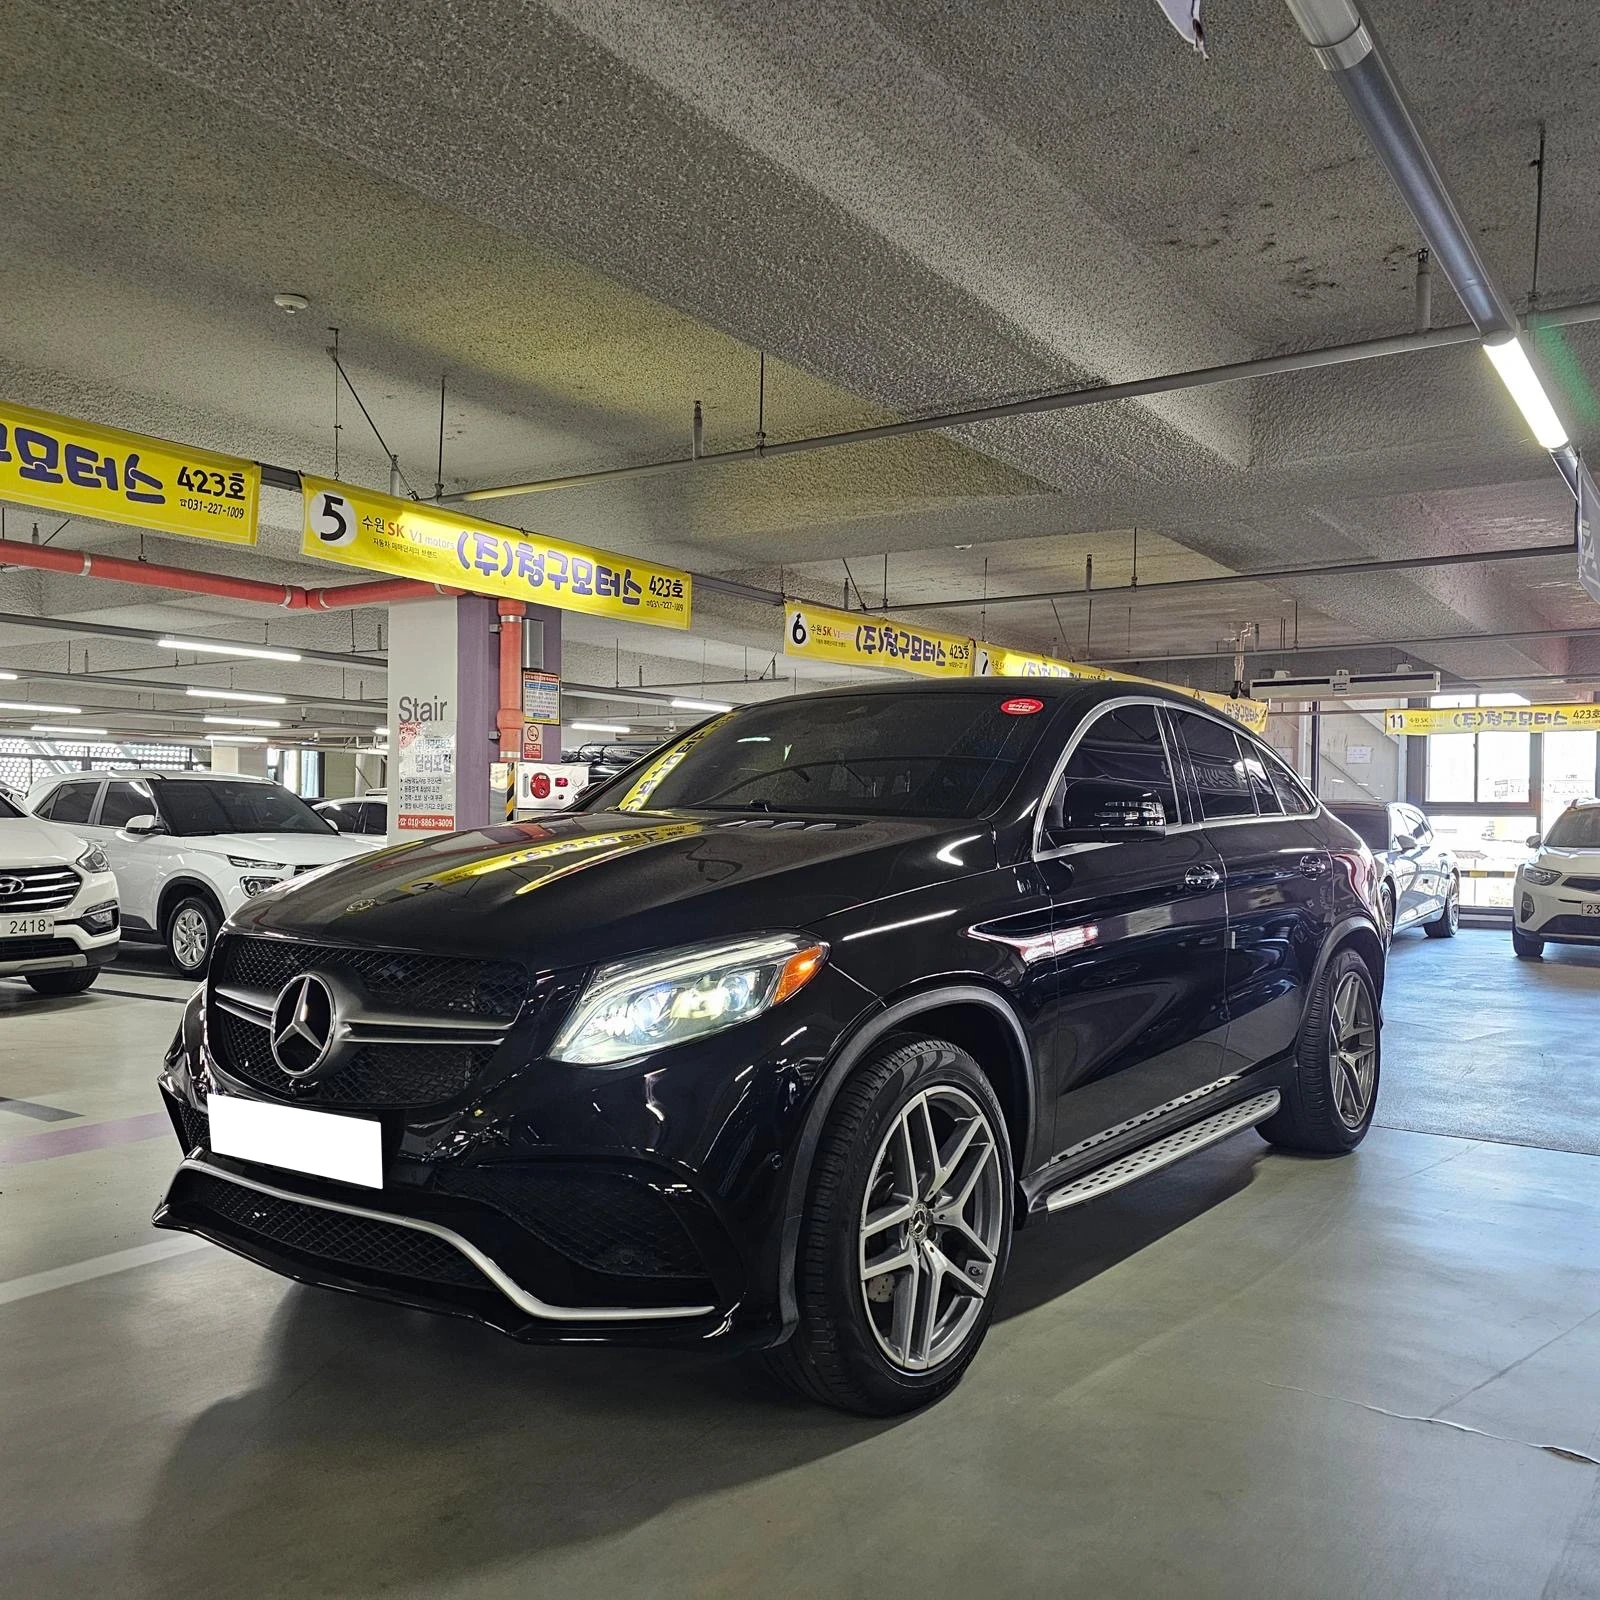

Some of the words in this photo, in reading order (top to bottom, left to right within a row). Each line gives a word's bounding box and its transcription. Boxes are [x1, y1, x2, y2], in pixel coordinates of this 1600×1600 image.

[0, 422, 165, 504] 모터스
[177, 466, 246, 500] 423호
[187, 499, 245, 519] 031-227-1009
[320, 494, 347, 541] 5
[361, 515, 385, 534] 수원
[387, 522, 405, 538] SK
[456, 530, 642, 606] (주)청구모터스
[648, 575, 684, 599] 423호
[792, 613, 807, 645] 6
[822, 626, 832, 637] SK
[855, 625, 946, 667] (주)청구모터스
[949, 644, 970, 660] 423호
[398, 695, 448, 723] Stair
[1389, 714, 1403, 729] 11
[9, 918, 46, 934] 2418
